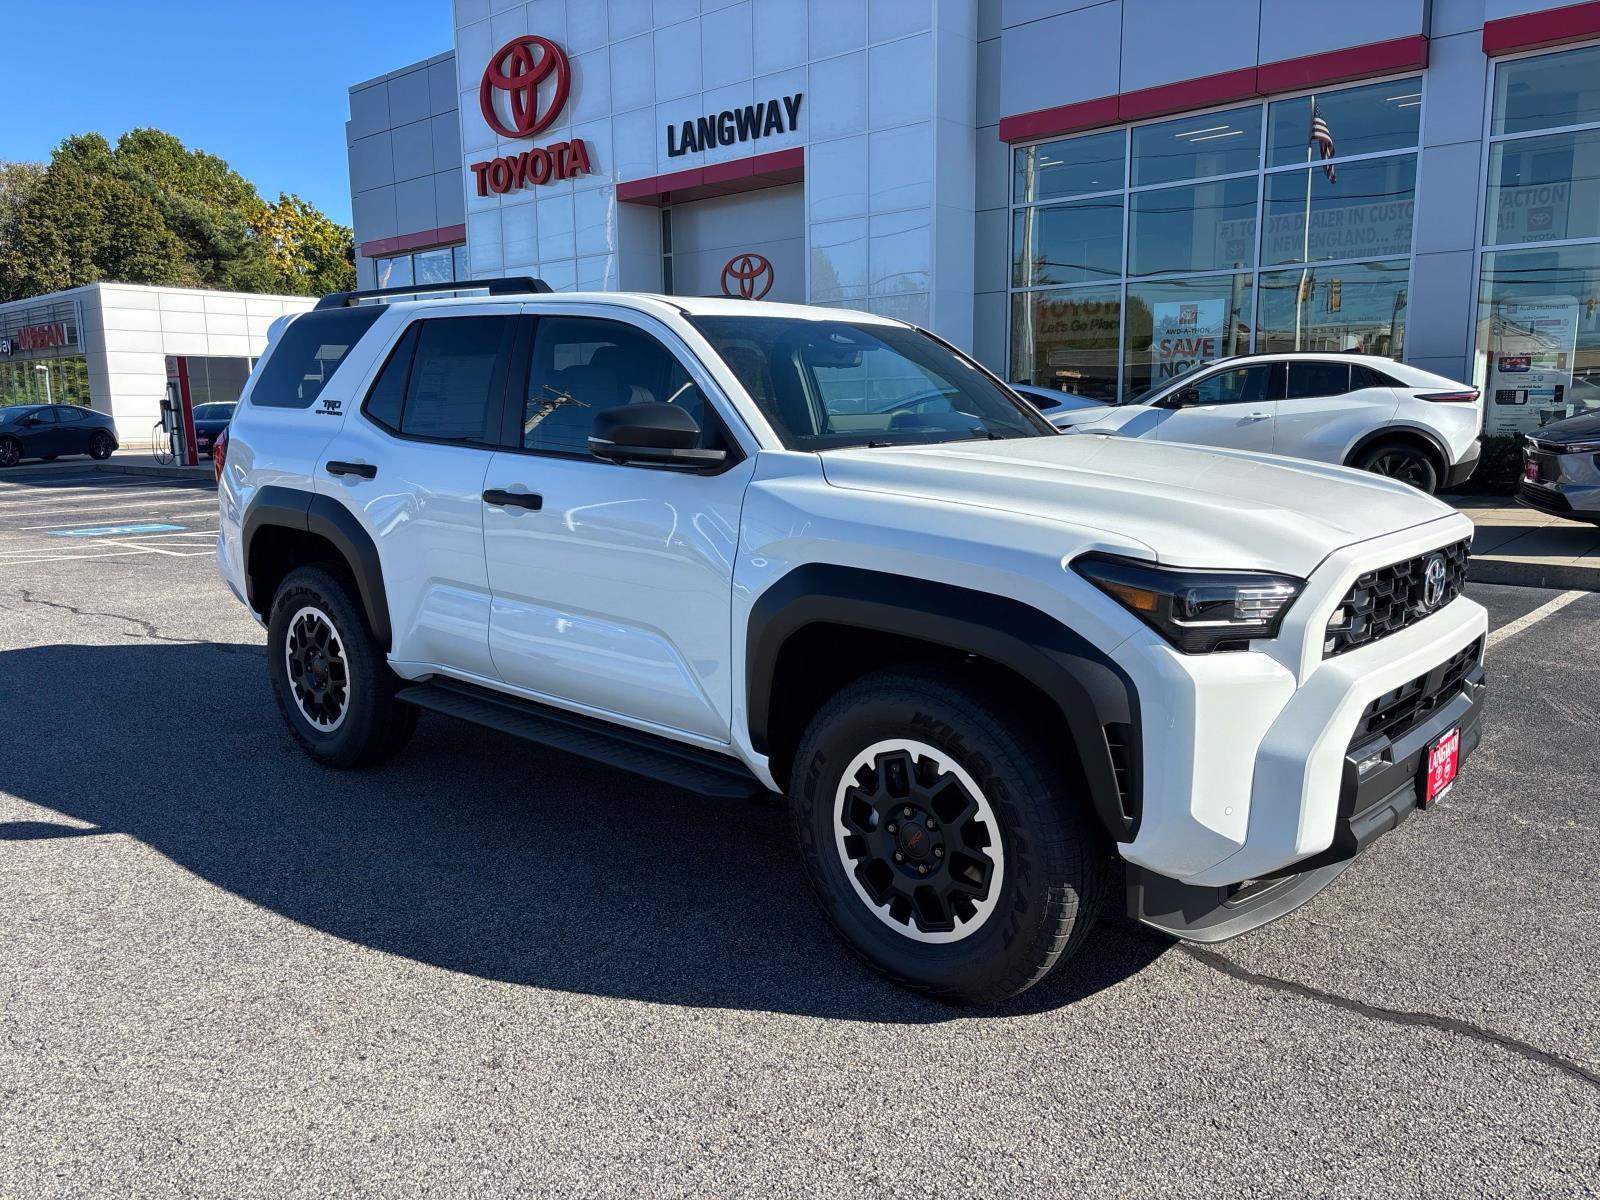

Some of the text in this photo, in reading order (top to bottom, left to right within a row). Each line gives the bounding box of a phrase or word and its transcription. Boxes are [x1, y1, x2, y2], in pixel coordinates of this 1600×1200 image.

[667, 93, 803, 158] LANGWAY
[471, 138, 592, 197] TOYOTA
[1350, 207, 1364, 225] IN
[1071, 319, 1088, 332] Go
[1165, 327, 1210, 335] AWD-A-THON
[16, 323, 67, 350] NISSAN
[1160, 337, 1215, 358] SAVE
[323, 400, 341, 410] TRD
[1429, 731, 1459, 773] LANGWAY
